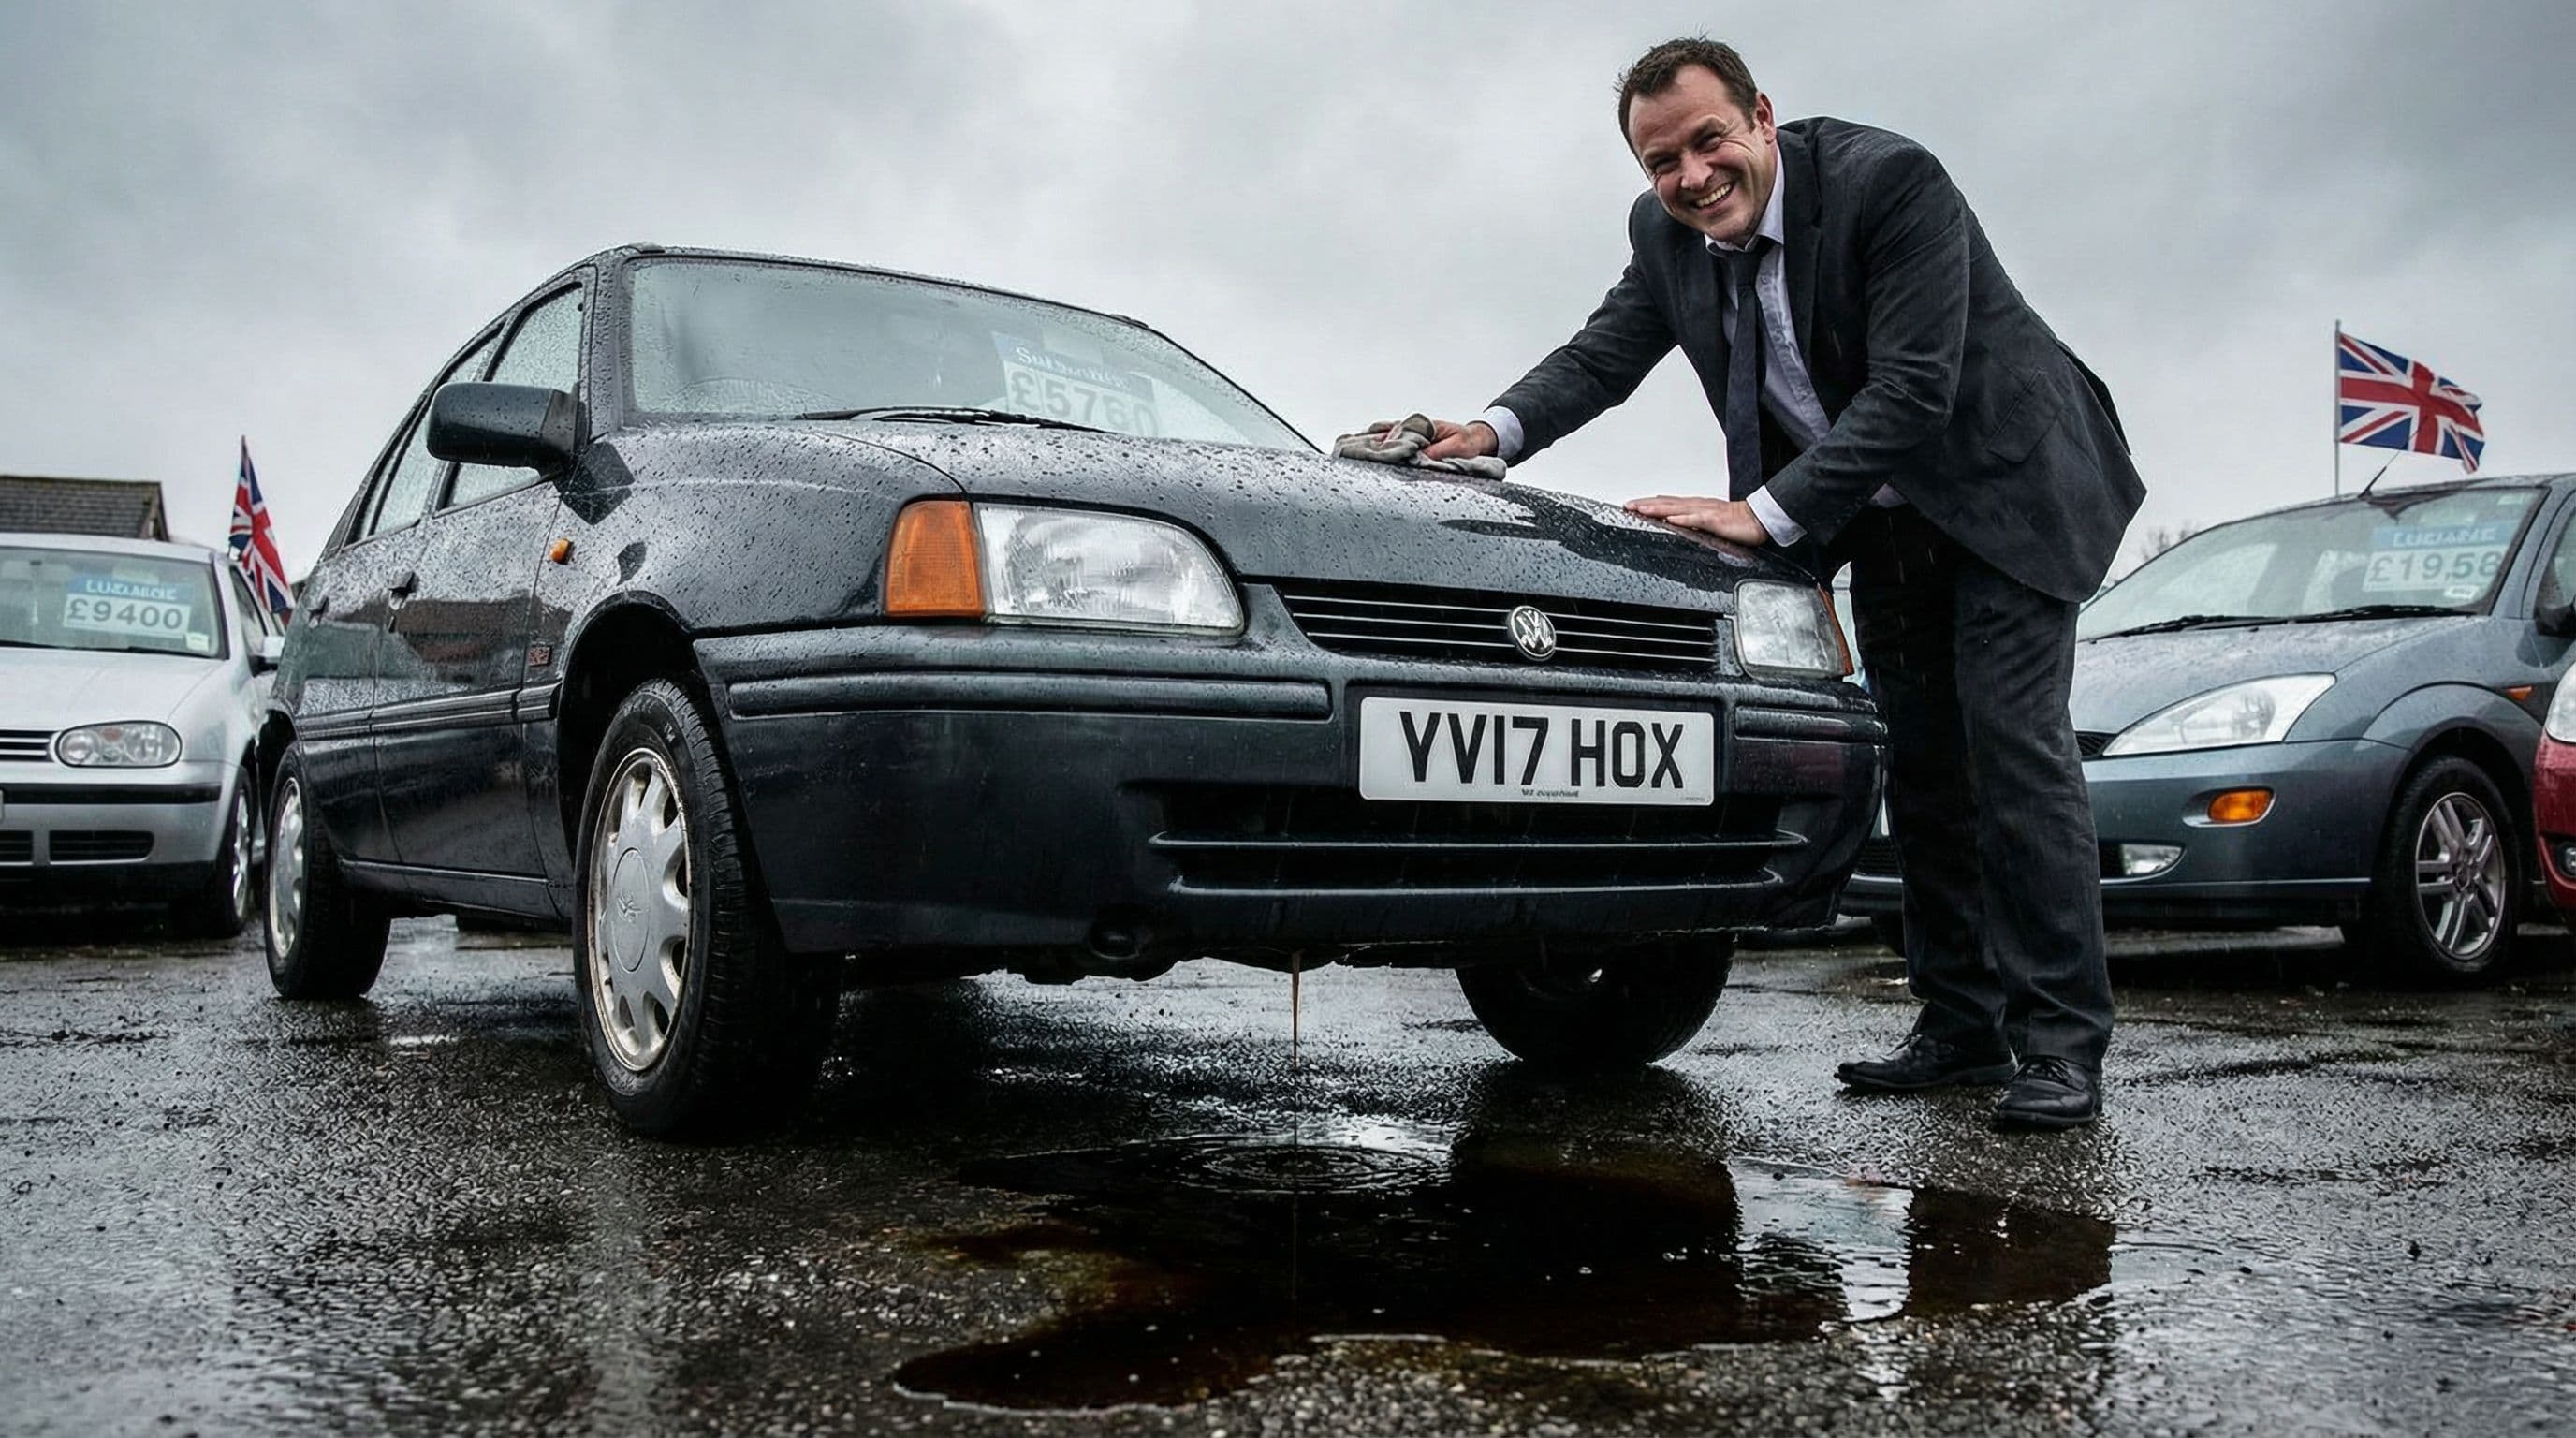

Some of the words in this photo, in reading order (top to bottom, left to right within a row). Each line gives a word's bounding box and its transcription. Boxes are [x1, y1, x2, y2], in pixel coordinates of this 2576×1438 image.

[66, 598, 183, 630] £9400
[1398, 711, 1550, 786] YV17
[1570, 717, 1685, 789] HOX
